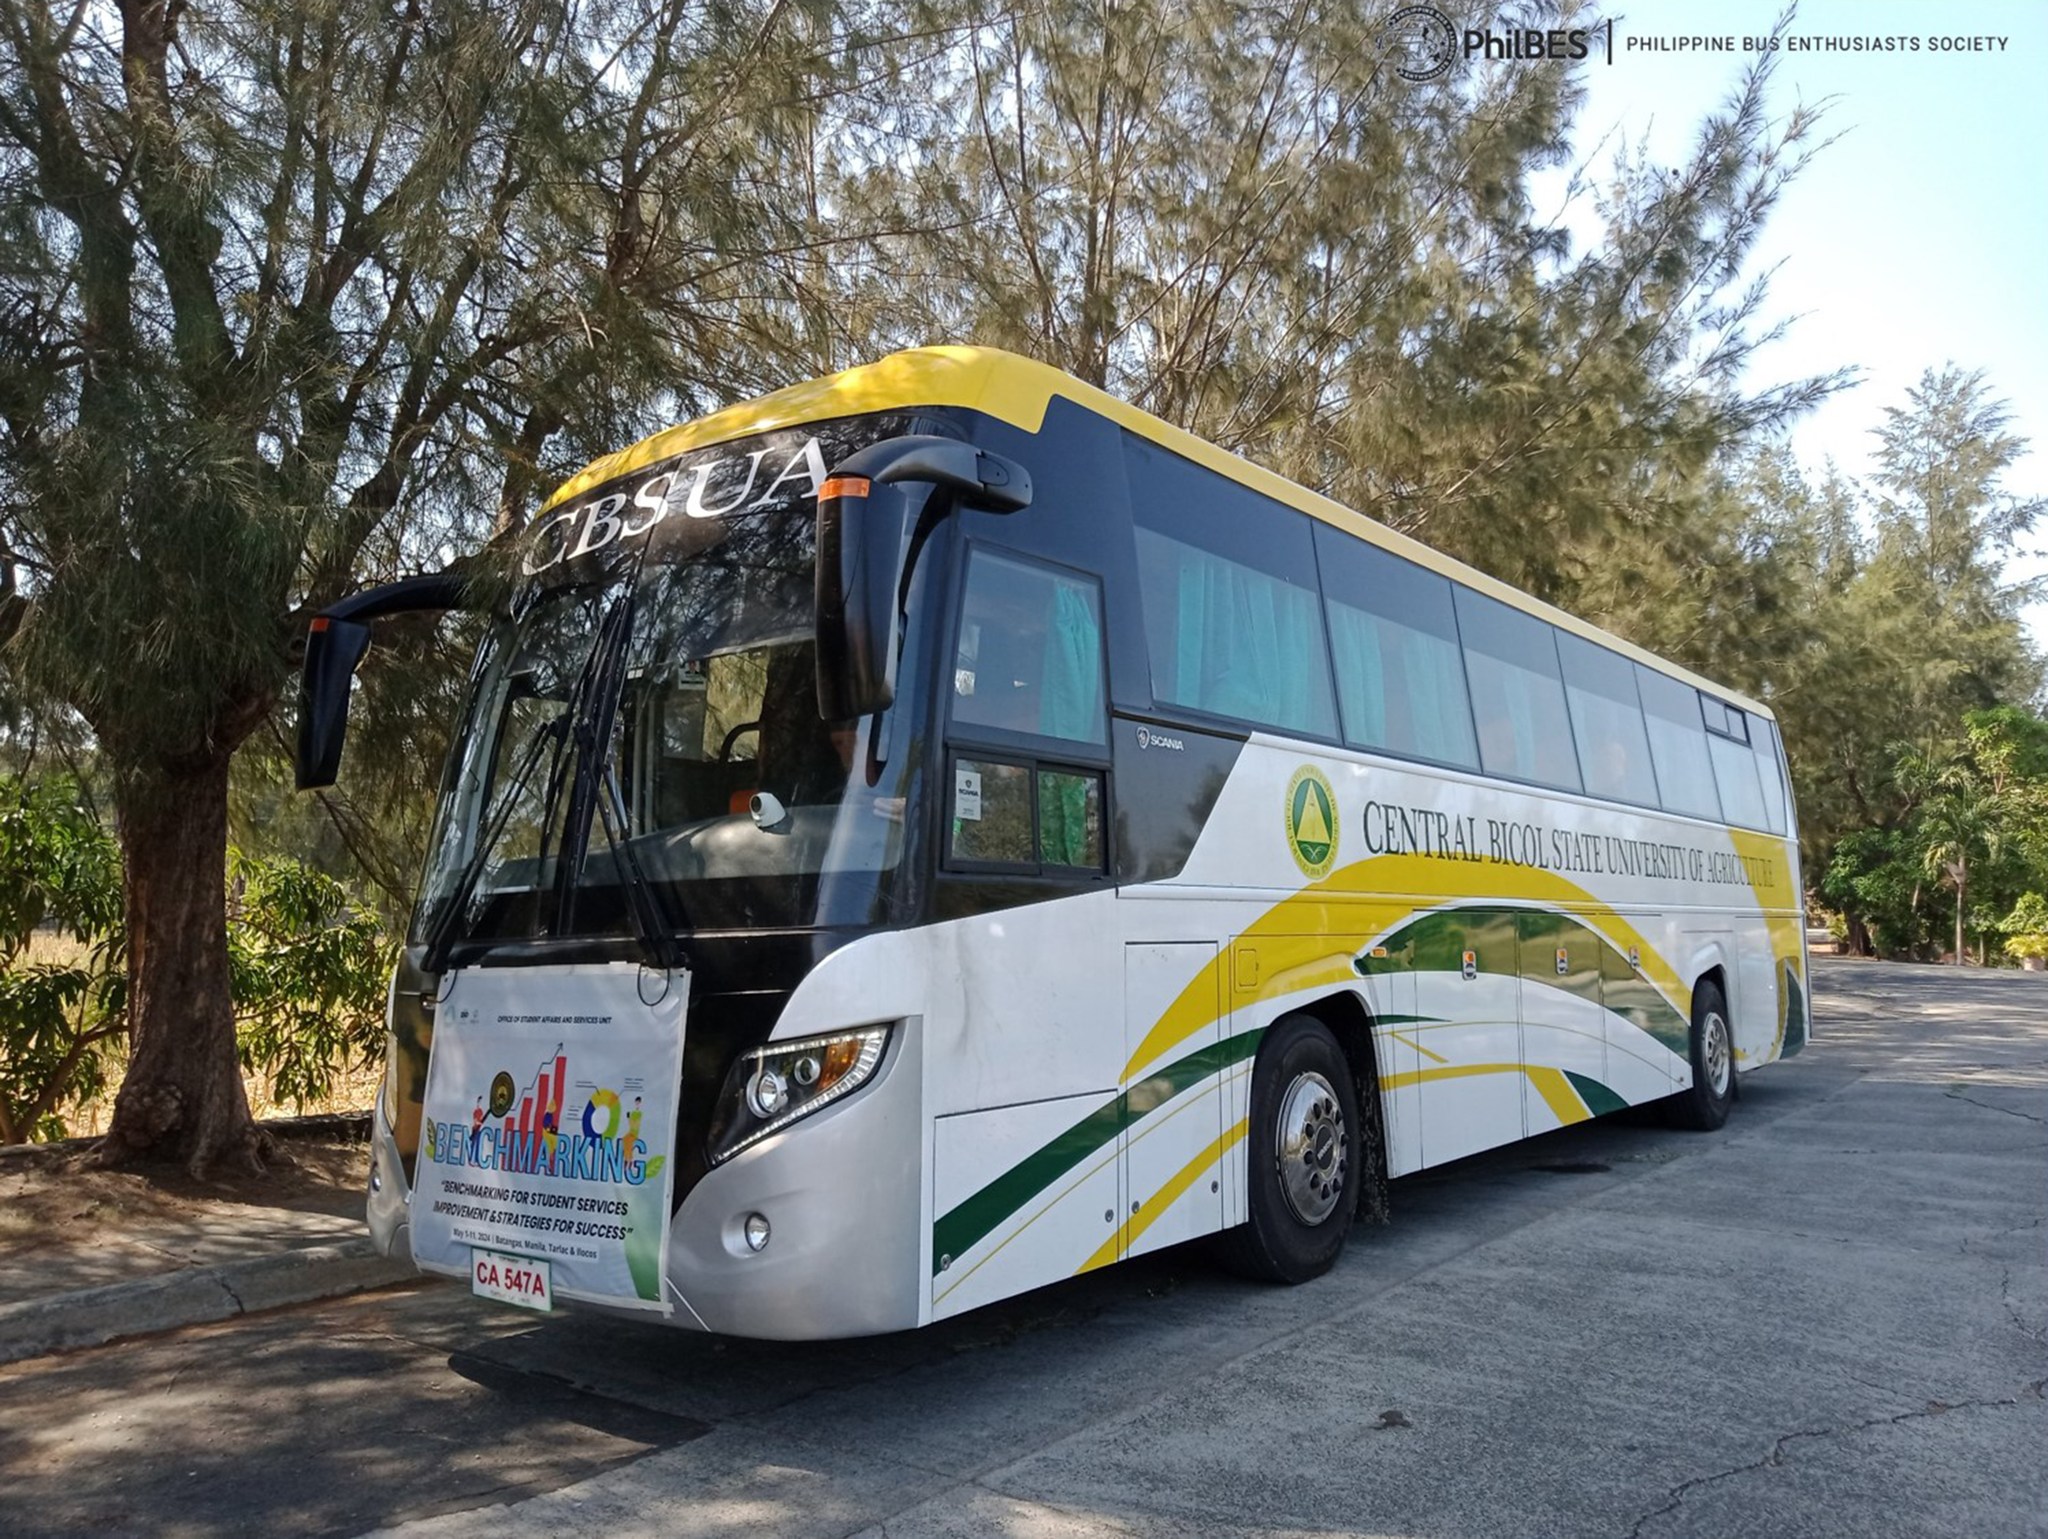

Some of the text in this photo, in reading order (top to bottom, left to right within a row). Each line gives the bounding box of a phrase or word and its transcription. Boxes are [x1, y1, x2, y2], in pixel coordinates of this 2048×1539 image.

[522, 437, 828, 576] CBSUA
[1150, 734, 1184, 751] SCANIA
[1363, 800, 1775, 888] CENTRAL BICOL STATE UNIVERSITY OF AGRICULTURE
[433, 1123, 648, 1185] BENCHMARKING
[433, 1201, 488, 1222] IMPROVEMENT
[496, 1211, 551, 1231] STRATEGIES
[552, 1219, 575, 1234] FOR
[510, 1190, 530, 1204] FOR
[530, 1192, 576, 1210] STUDENT
[577, 1198, 628, 1216] SERVICES
[548, 1243, 568, 1255] Tarlac
[570, 1246, 576, 1255] &
[576, 1247, 597, 1259] Ilocos
[477, 1262, 500, 1287] CA
[504, 1267, 545, 1298] 547A
